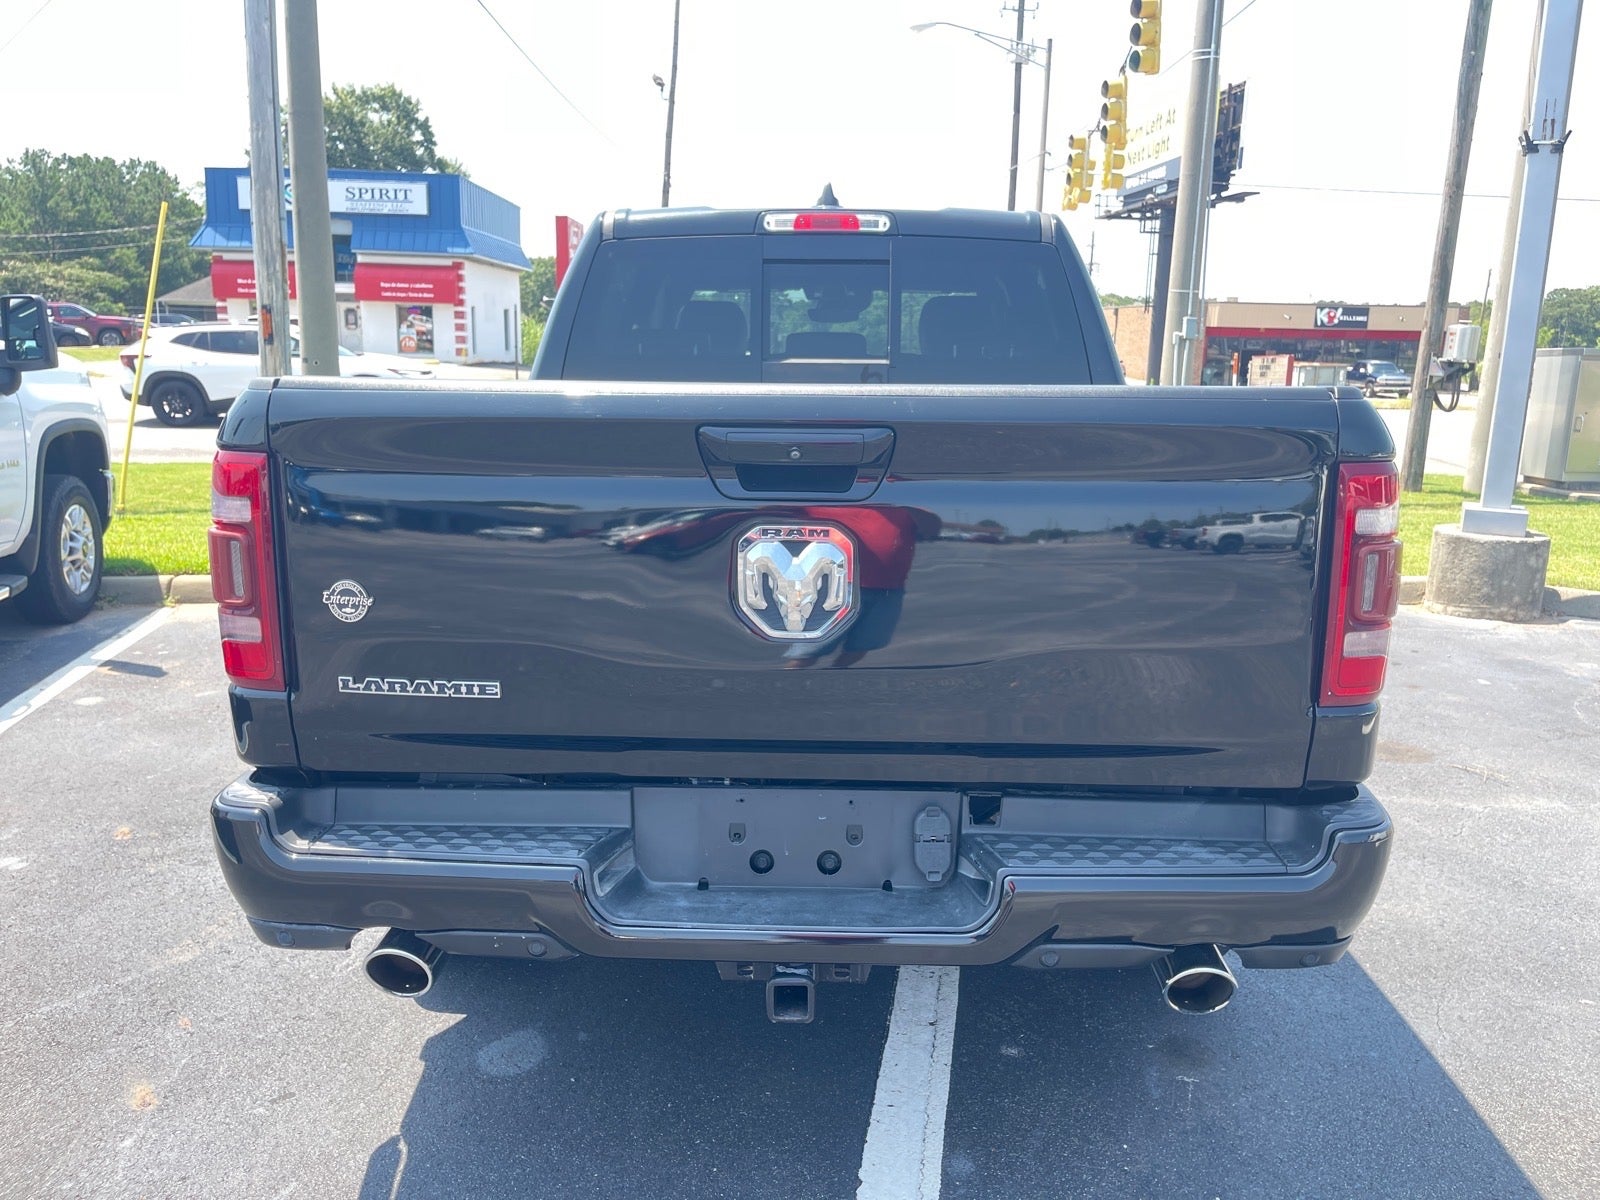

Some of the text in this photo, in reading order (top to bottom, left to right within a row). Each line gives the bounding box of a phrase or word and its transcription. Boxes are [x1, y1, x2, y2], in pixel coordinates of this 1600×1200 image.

[1146, 112, 1163, 136] Left
[1165, 108, 1176, 126] At
[1127, 135, 1170, 165] Next Light
[345, 186, 413, 201] SPIRIT
[760, 527, 830, 539] RAM
[322, 590, 373, 609] Enterprise
[338, 675, 501, 699] LARAMIE
